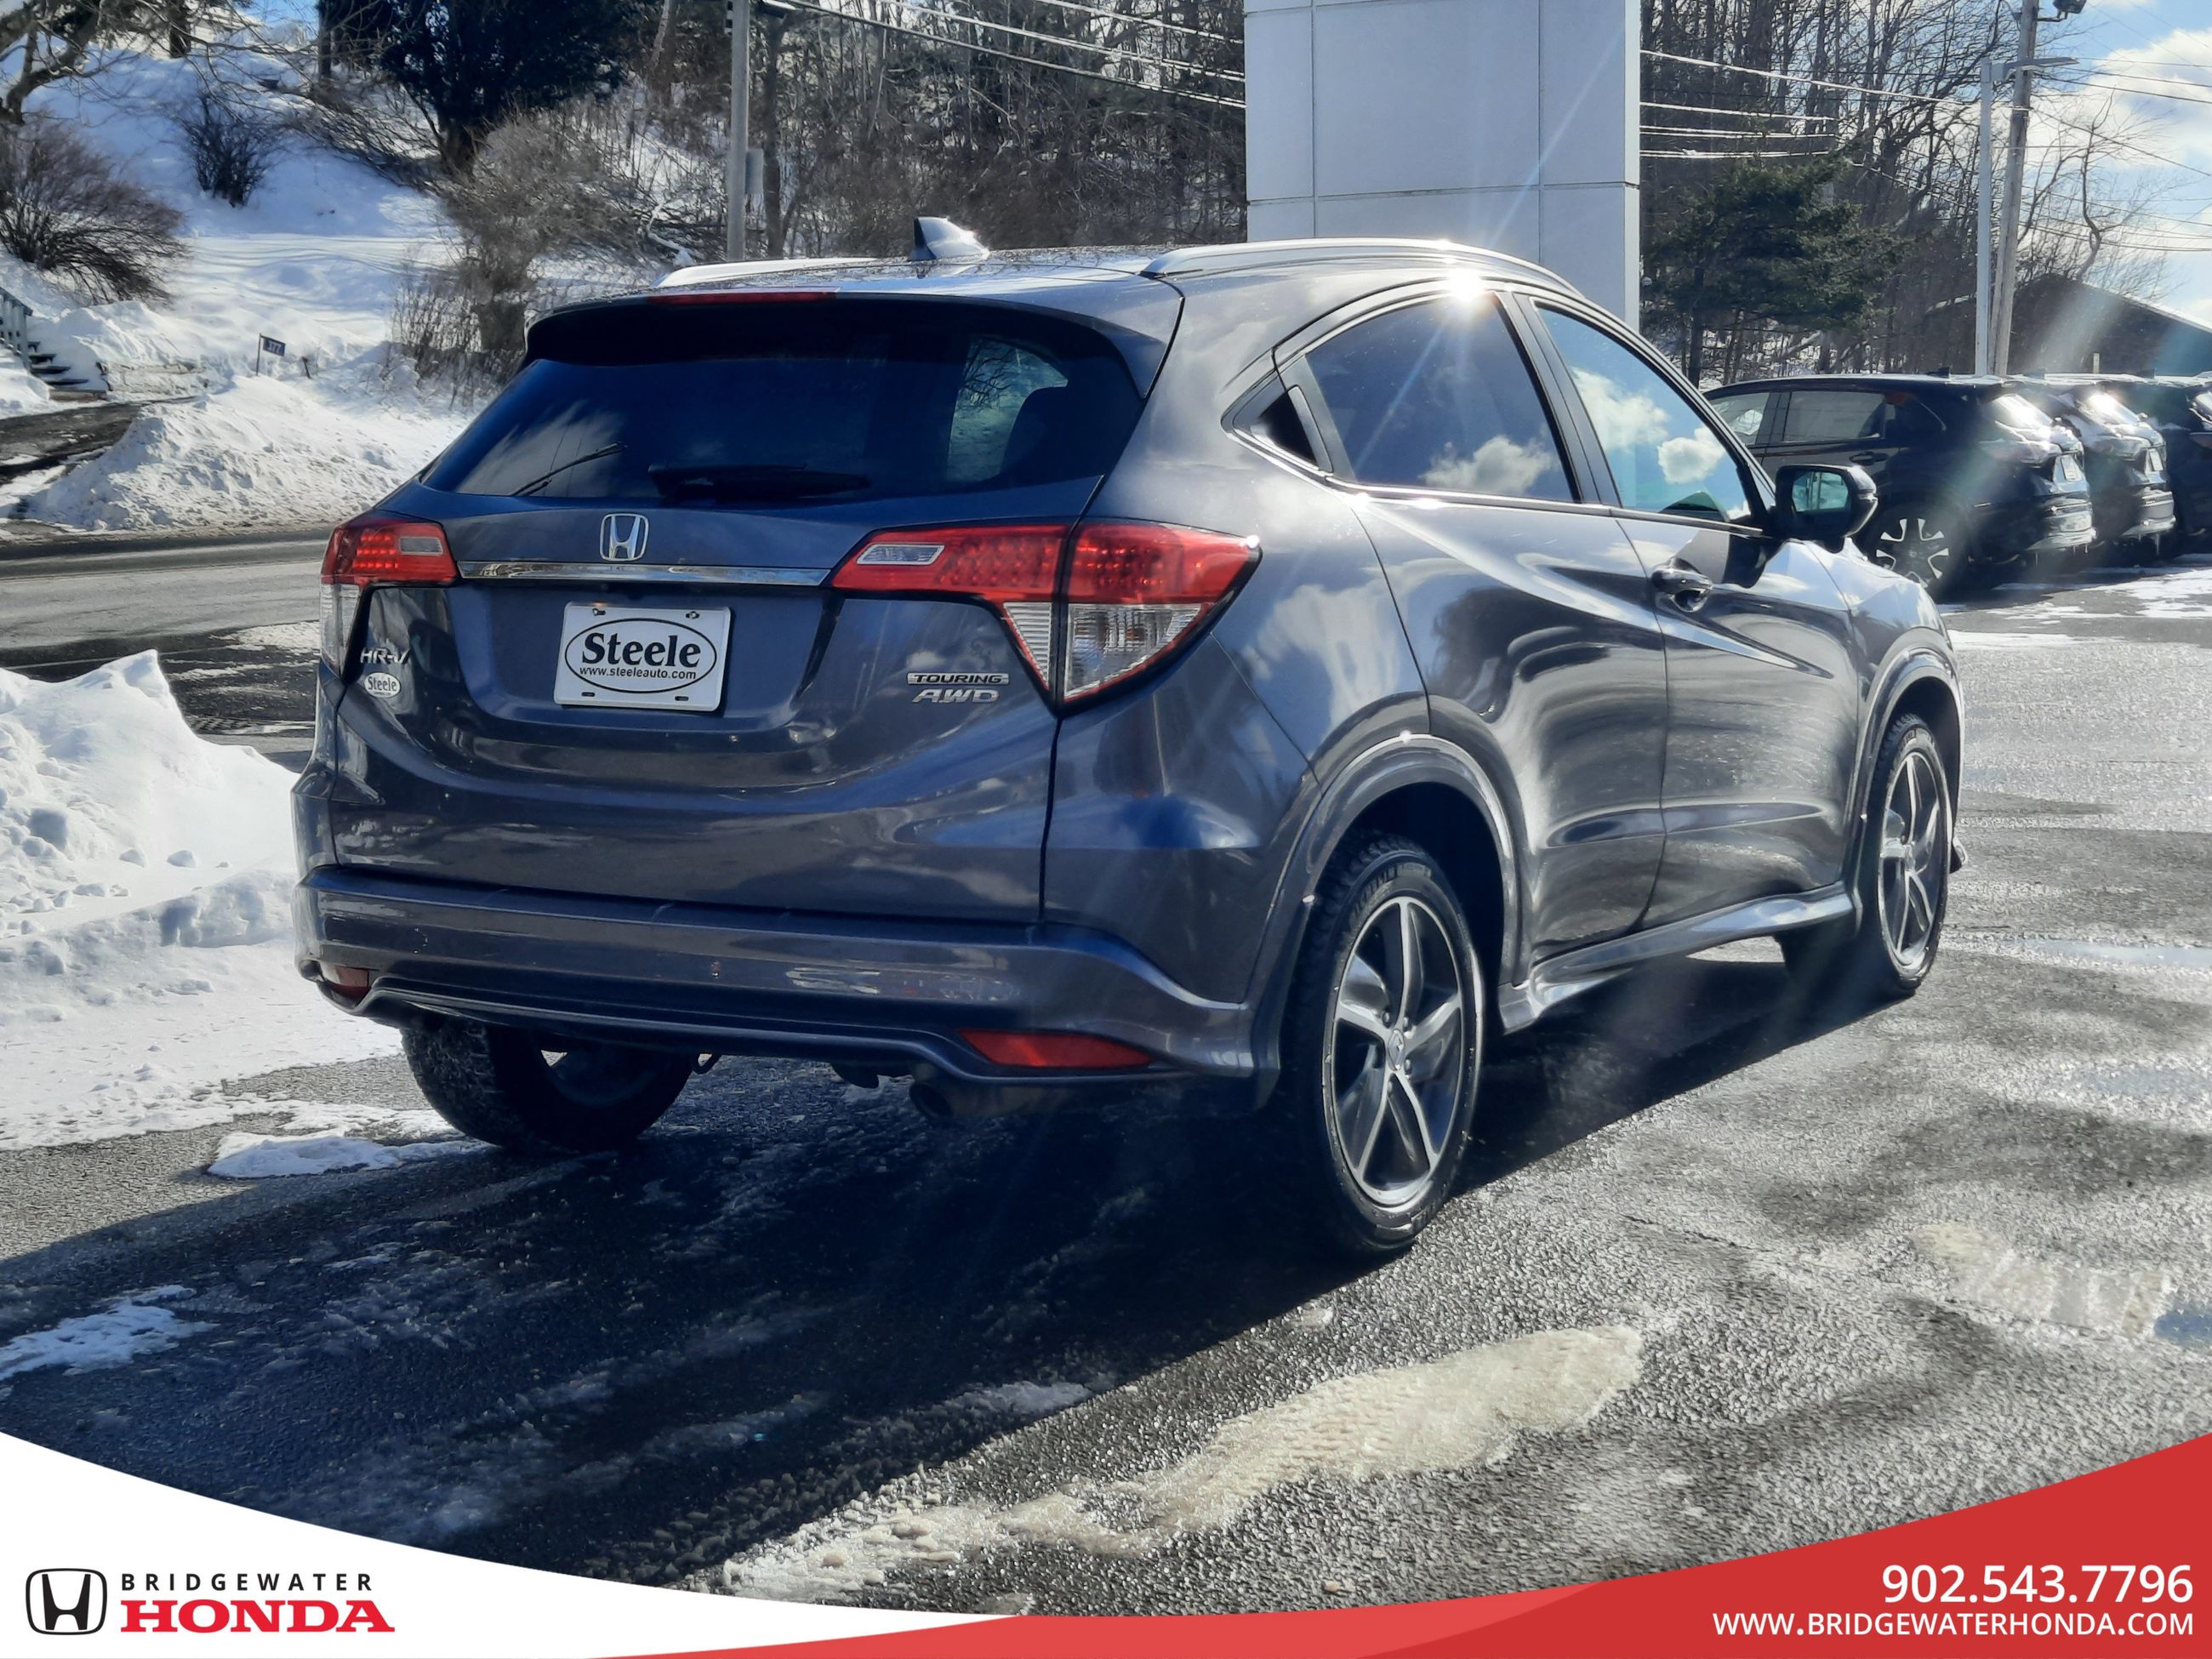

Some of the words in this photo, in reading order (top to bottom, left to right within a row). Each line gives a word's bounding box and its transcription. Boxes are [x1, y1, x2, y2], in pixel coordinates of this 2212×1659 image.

[580, 631, 701, 668] Steele
[579, 665, 697, 680] www.steeleauto.com
[914, 674, 1003, 684] TOURING
[368, 676, 398, 693] Steele
[911, 688, 1000, 704] AWD
